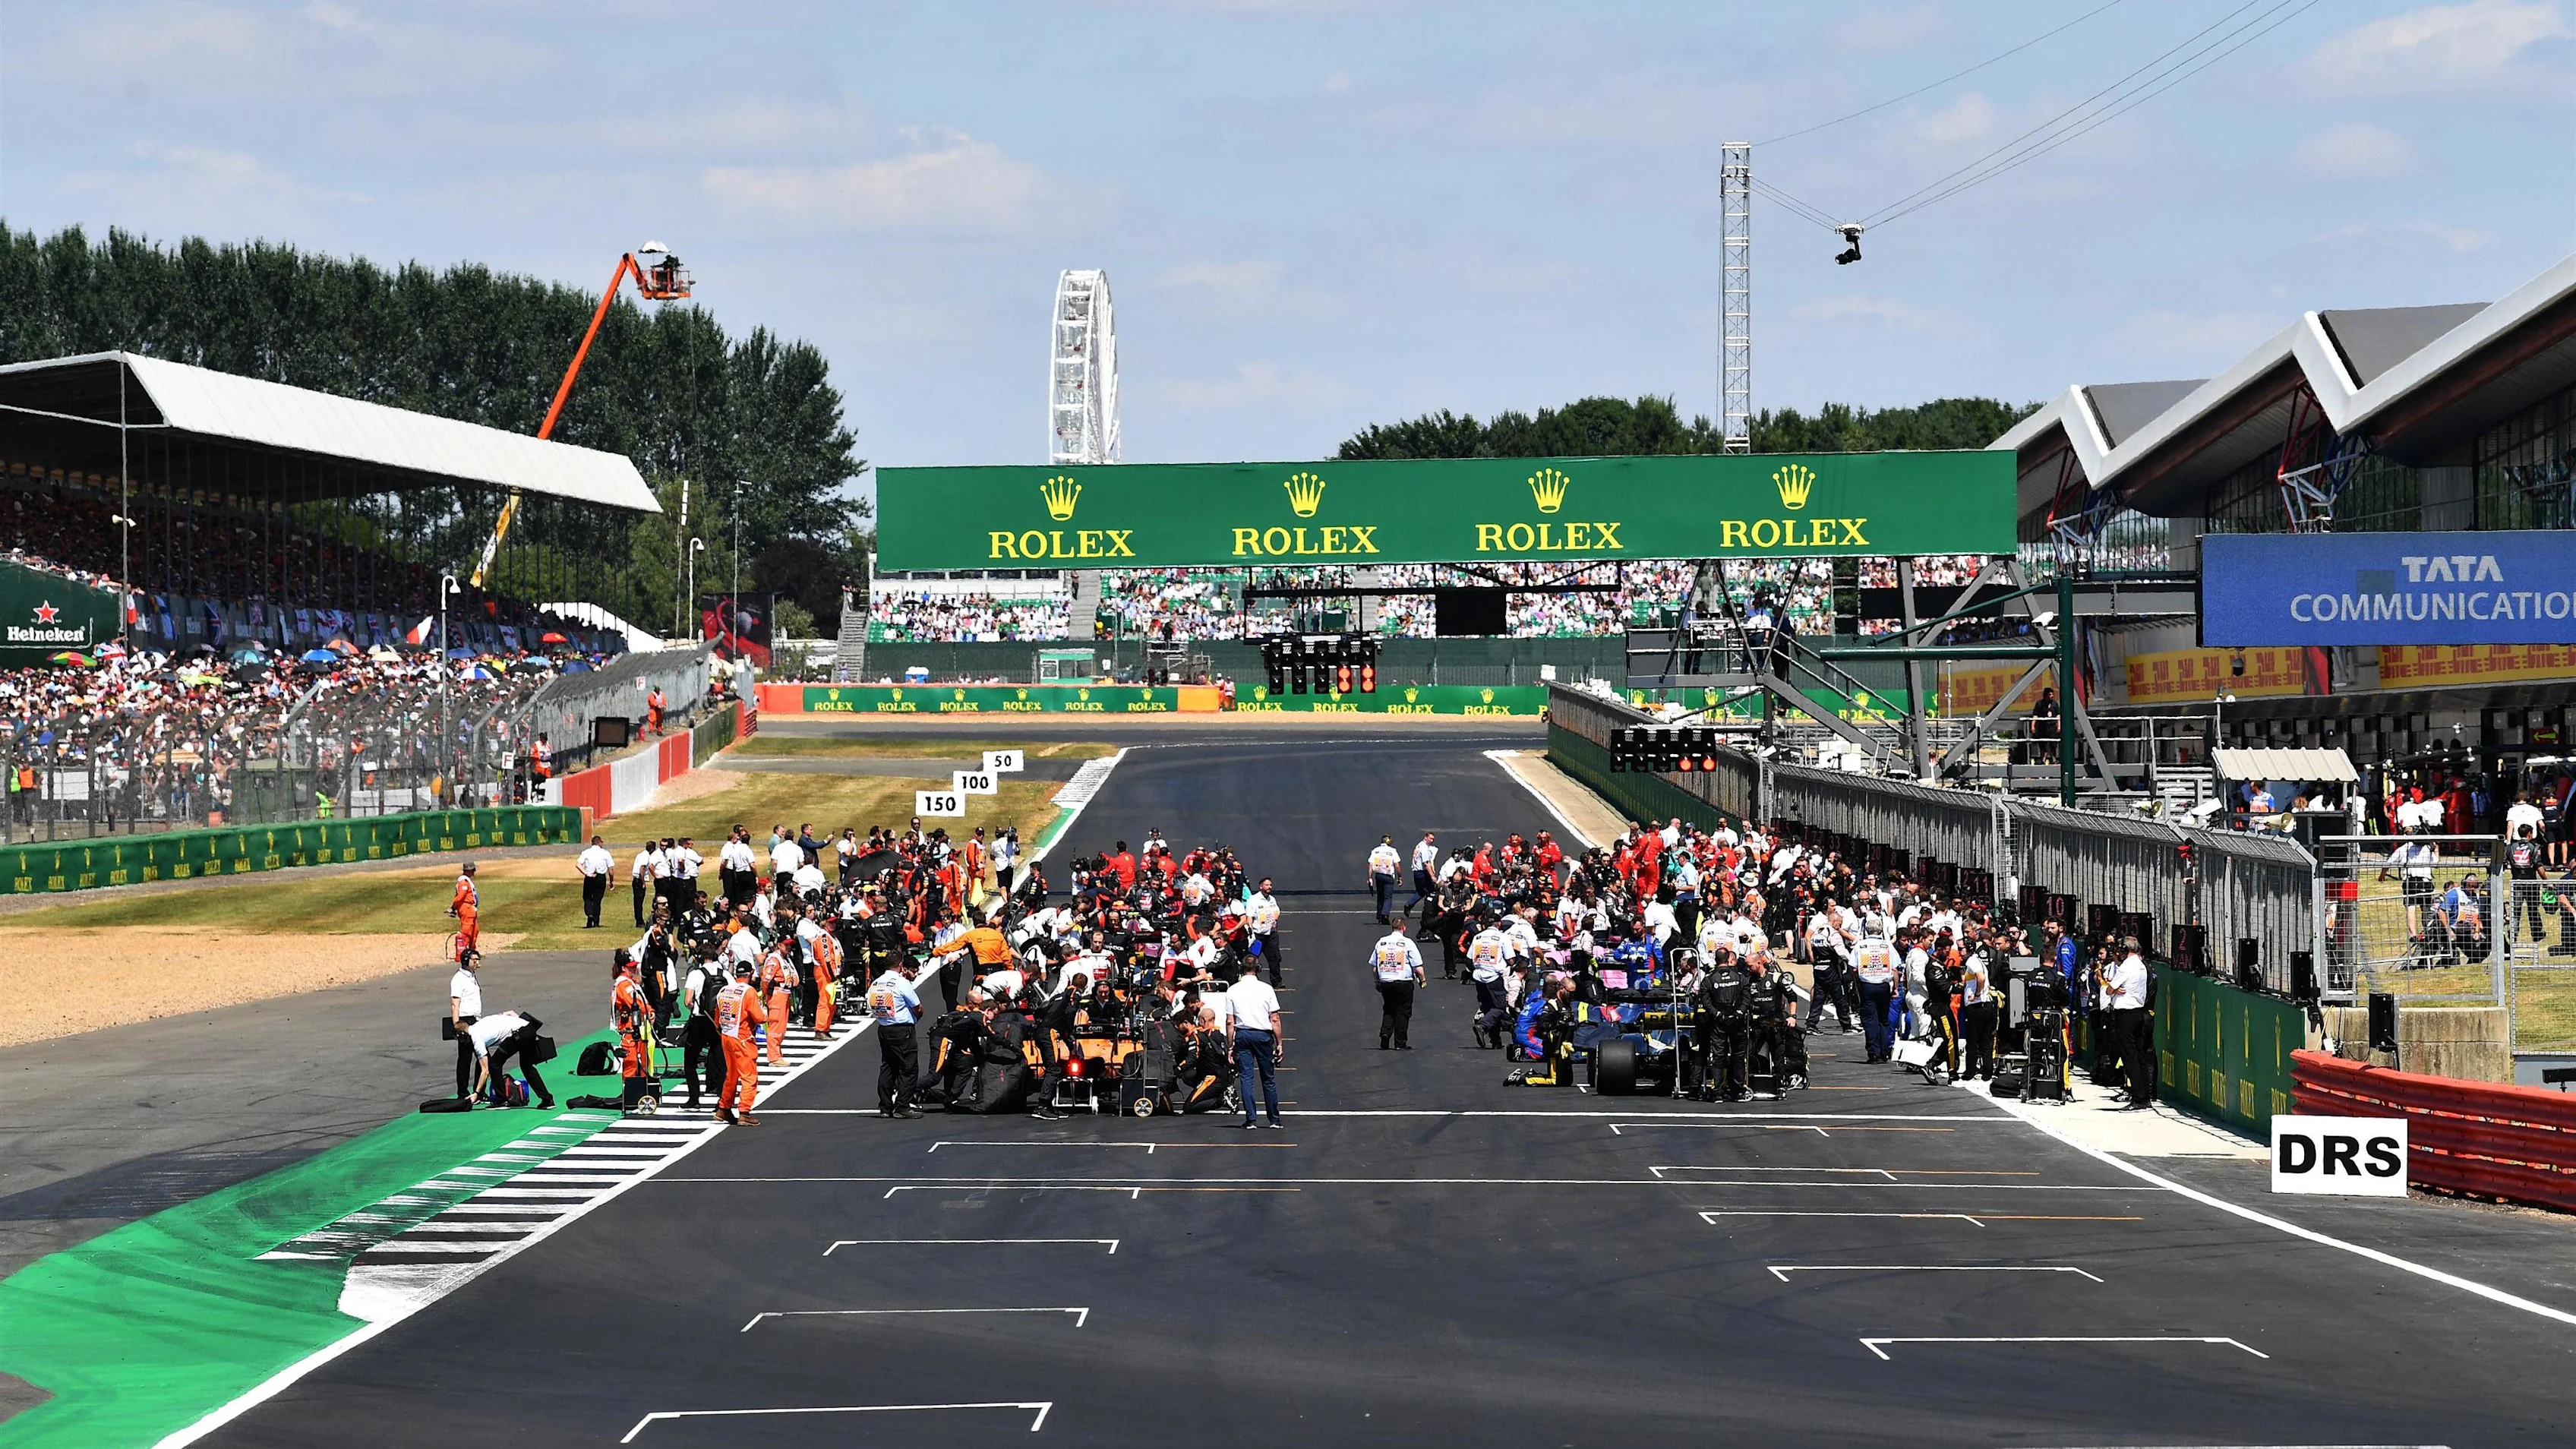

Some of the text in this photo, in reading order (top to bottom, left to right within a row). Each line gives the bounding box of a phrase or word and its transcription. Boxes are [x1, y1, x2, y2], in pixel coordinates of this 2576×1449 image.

[1235, 527, 1377, 554] ROLEX
[1479, 523, 1621, 551] ROLEX
[1722, 519, 1867, 547] ROLEX
[991, 531, 1132, 558] ROLEX
[2401, 555, 2505, 582] TATA
[7, 626, 85, 642] Heineken
[814, 702, 853, 712] ROLEX
[877, 702, 916, 712] ROLEX
[939, 702, 979, 712] ROLEX
[1003, 702, 1041, 711] ROLEX
[1065, 702, 1103, 711] ROLEX
[1128, 702, 1166, 711] ROLEX
[1237, 702, 1282, 712] ROLEX
[1313, 702, 1358, 712] ROLEX
[1388, 703, 1434, 714] ROLEX
[1463, 705, 1511, 715] ROLEX
[995, 755, 1012, 767] 50
[962, 776, 989, 789] 100
[925, 797, 956, 811] 150
[1829, 835, 1841, 851] 33
[1974, 875, 1989, 894] 11
[2047, 896, 2064, 916] 10
[2120, 915, 2139, 936] 55
[2180, 927, 2186, 952] 2
[2173, 953, 2192, 970] VAN
[2280, 1134, 2401, 1177] DRS
